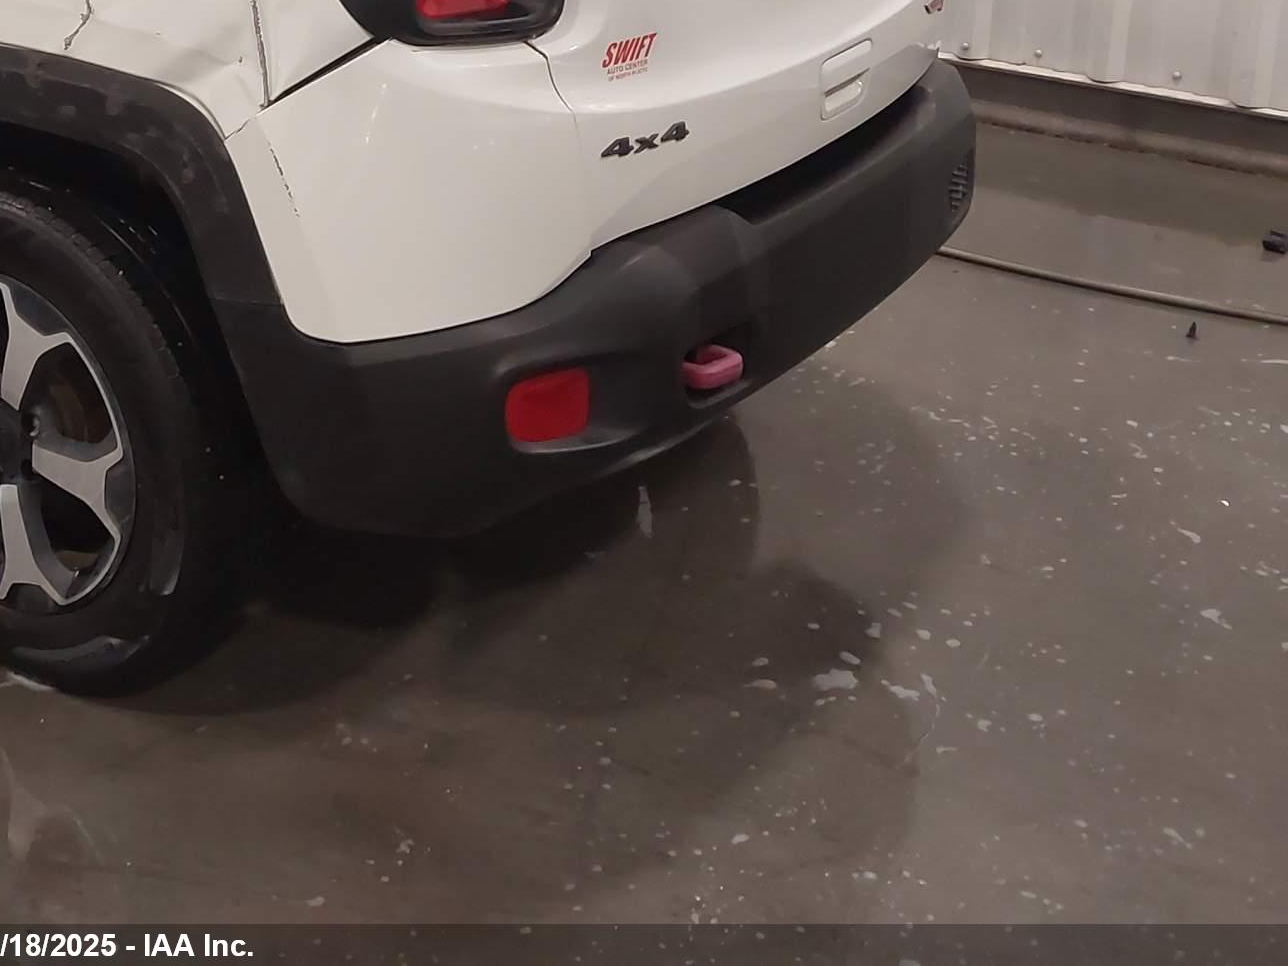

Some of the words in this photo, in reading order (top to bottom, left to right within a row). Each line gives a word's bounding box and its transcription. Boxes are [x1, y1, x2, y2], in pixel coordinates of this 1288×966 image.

[601, 32, 658, 68] SWIFT
[607, 65, 624, 75] AUTO
[624, 59, 648, 71] CENTER
[600, 121, 690, 157] 4x4
